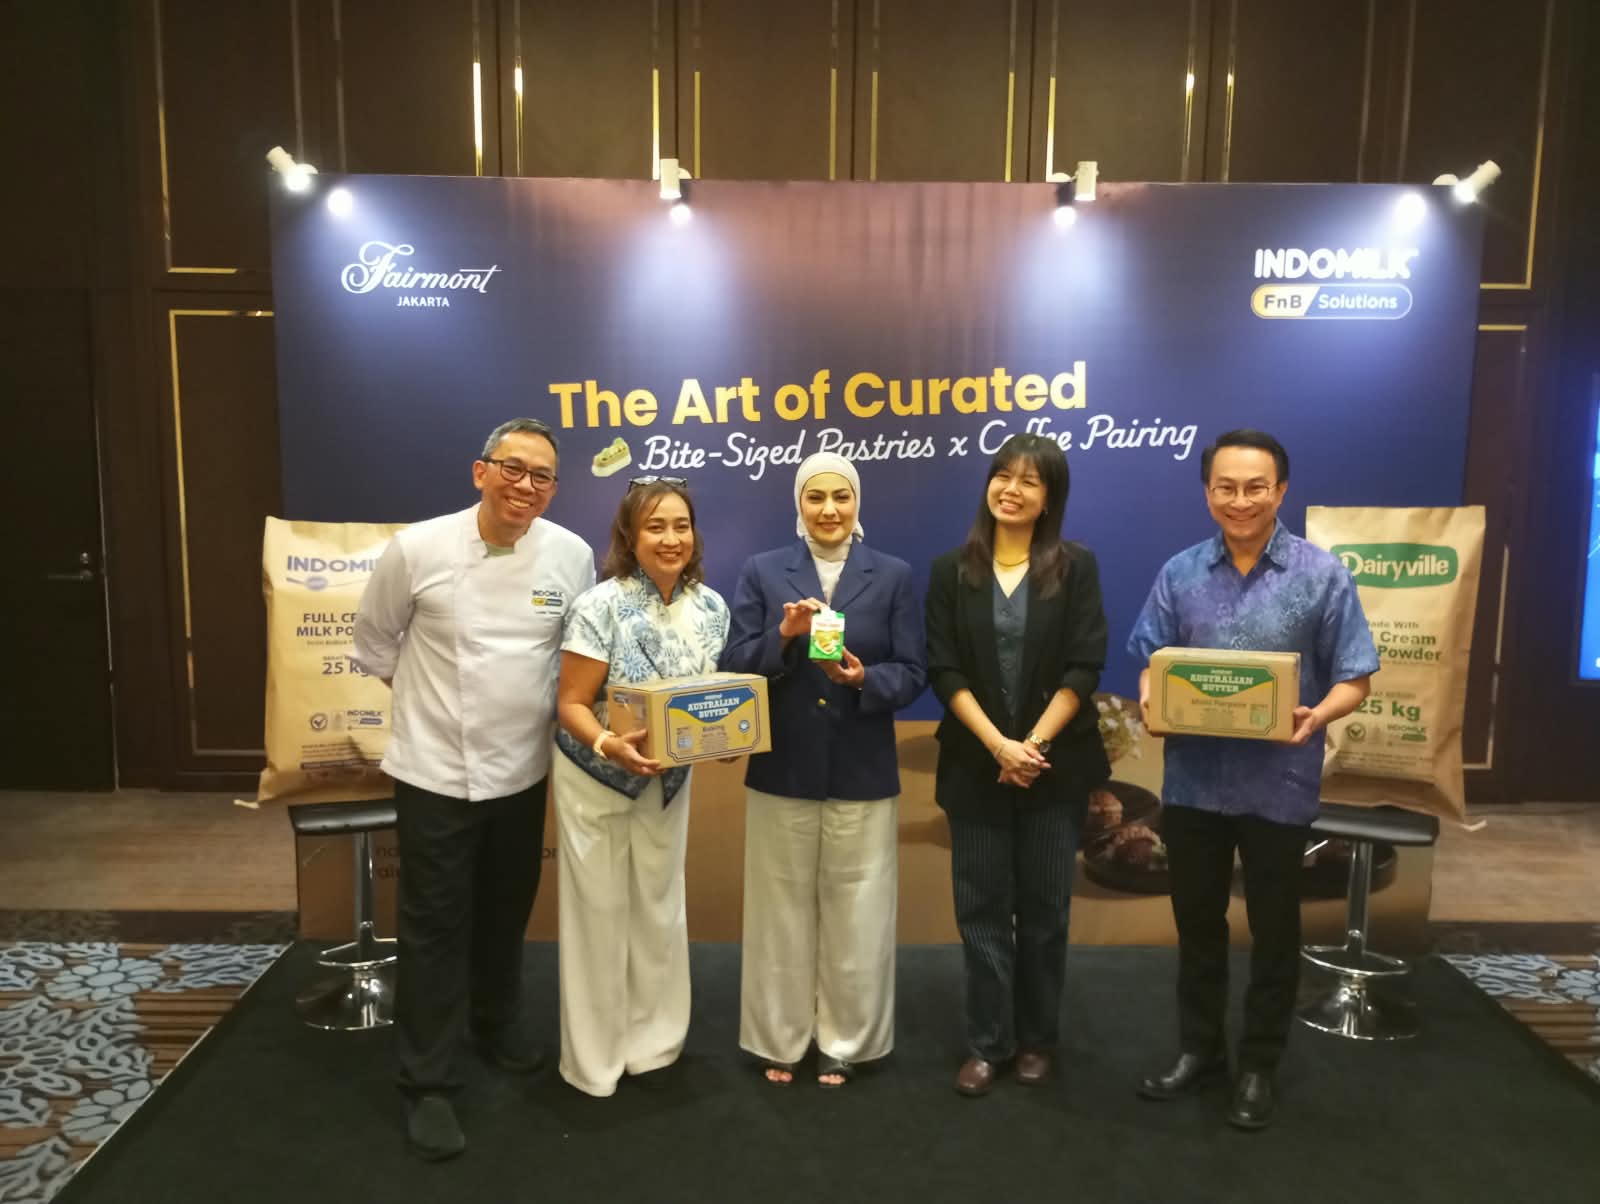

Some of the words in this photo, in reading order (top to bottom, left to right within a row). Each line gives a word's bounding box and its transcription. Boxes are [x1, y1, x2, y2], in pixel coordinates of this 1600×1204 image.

[340, 240, 502, 294] Fairmont
[1254, 247, 1420, 280] INDOMILK
[396, 296, 450, 308] JAKARTA
[1263, 294, 1302, 309] FnB
[1318, 293, 1398, 310] Solutions
[548, 379, 658, 429] The
[671, 377, 761, 425] Art
[774, 368, 830, 422] of
[843, 360, 1087, 418] Curated
[638, 429, 807, 481] Bite-Sized
[816, 427, 936, 461] Pastries
[948, 435, 969, 458] x
[1079, 414, 1198, 461] Pairing
[1338, 551, 1450, 582] Dairyville
[303, 612, 338, 624] FULL
[1367, 620, 1391, 629] ade
[296, 625, 332, 637] MILK
[1380, 631, 1437, 646] Cream
[1376, 645, 1443, 661] Powder
[321, 661, 345, 676] 25
[1190, 673, 1254, 686] AUSTRALIAN
[1201, 682, 1240, 693] BUTTER
[687, 696, 740, 712] AUSTRALIAN
[1354, 698, 1383, 715] 25
[1391, 700, 1421, 722] kg
[698, 707, 730, 719] BUTTER
